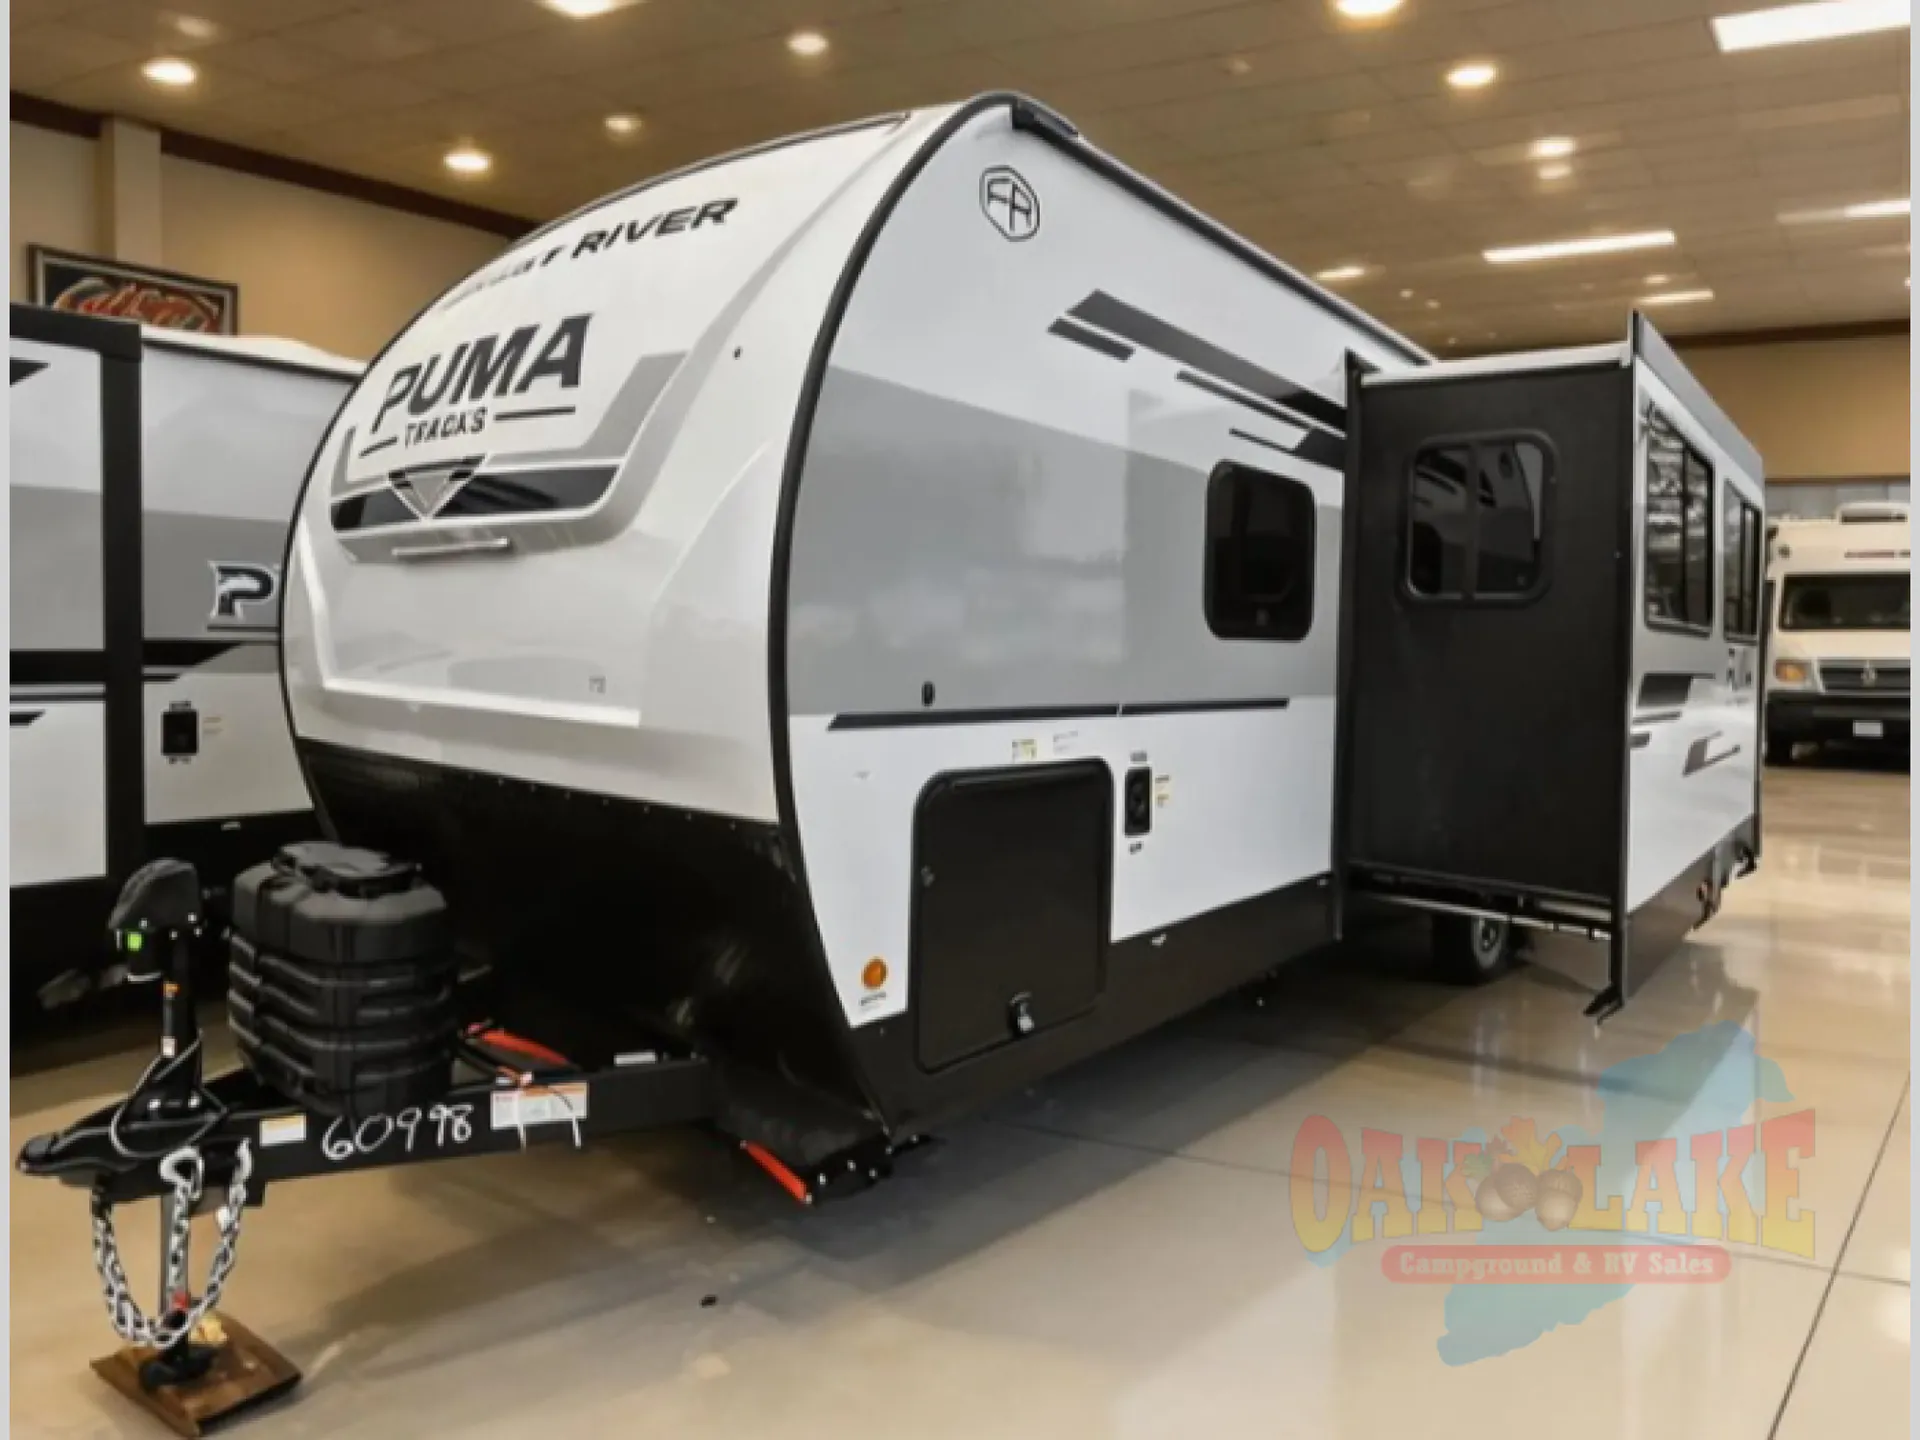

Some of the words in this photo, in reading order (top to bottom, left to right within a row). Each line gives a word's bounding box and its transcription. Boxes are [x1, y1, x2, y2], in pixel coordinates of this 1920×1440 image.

[571, 197, 739, 259] RIVER
[371, 312, 593, 434] PUMA
[321, 1103, 474, 1161] 60998
